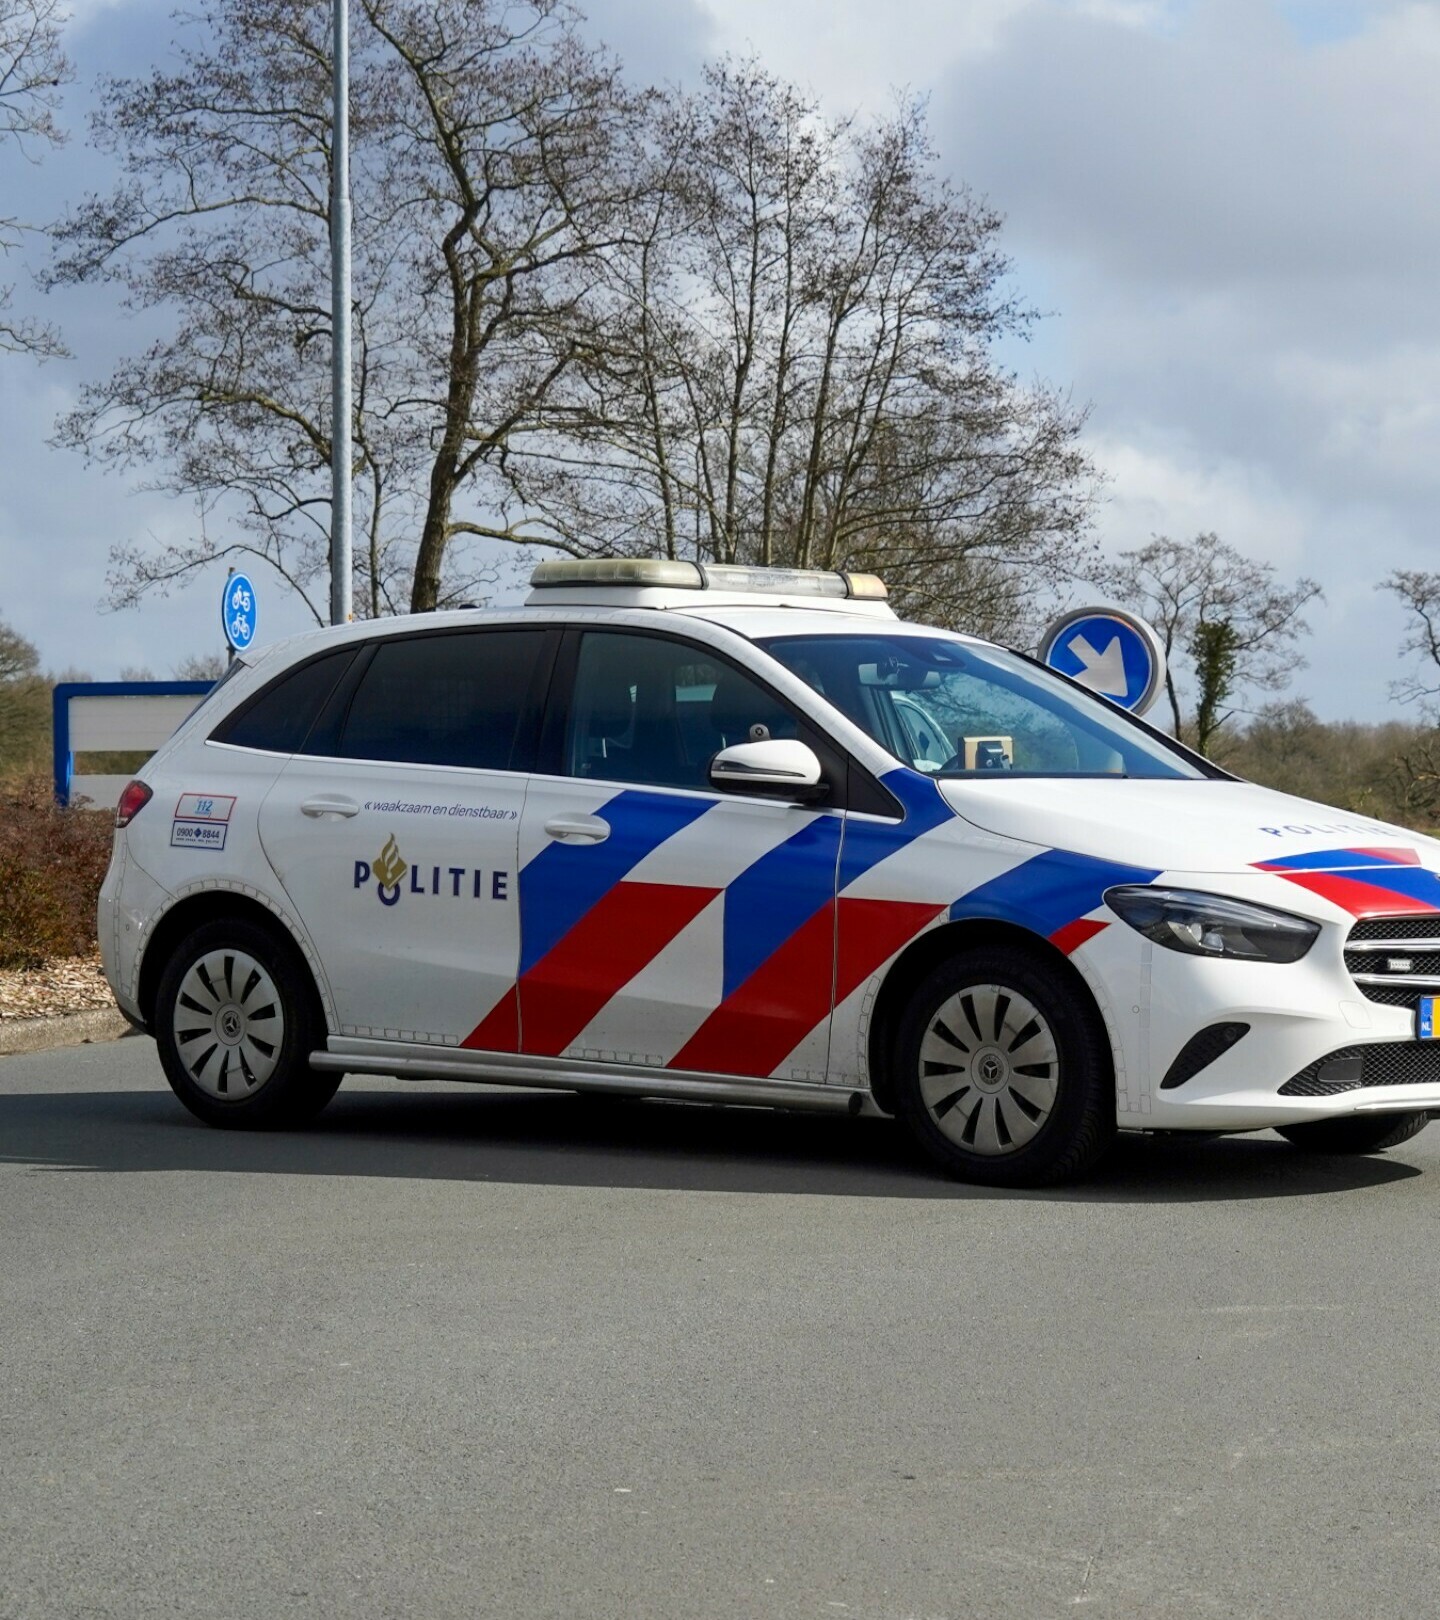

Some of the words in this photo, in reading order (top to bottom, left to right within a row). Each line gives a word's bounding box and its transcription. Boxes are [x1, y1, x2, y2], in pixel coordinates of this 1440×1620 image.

[197, 800, 214, 812] 112
[373, 800, 432, 815] waakzaam
[432, 806, 449, 815] en
[448, 803, 508, 820] dienstbaar
[176, 827, 194, 838] 0900
[202, 829, 220, 839] 8844
[1258, 824, 1400, 838] POLITIE
[354, 855, 508, 906] POLITIE
[1421, 1021, 1432, 1032] NL
